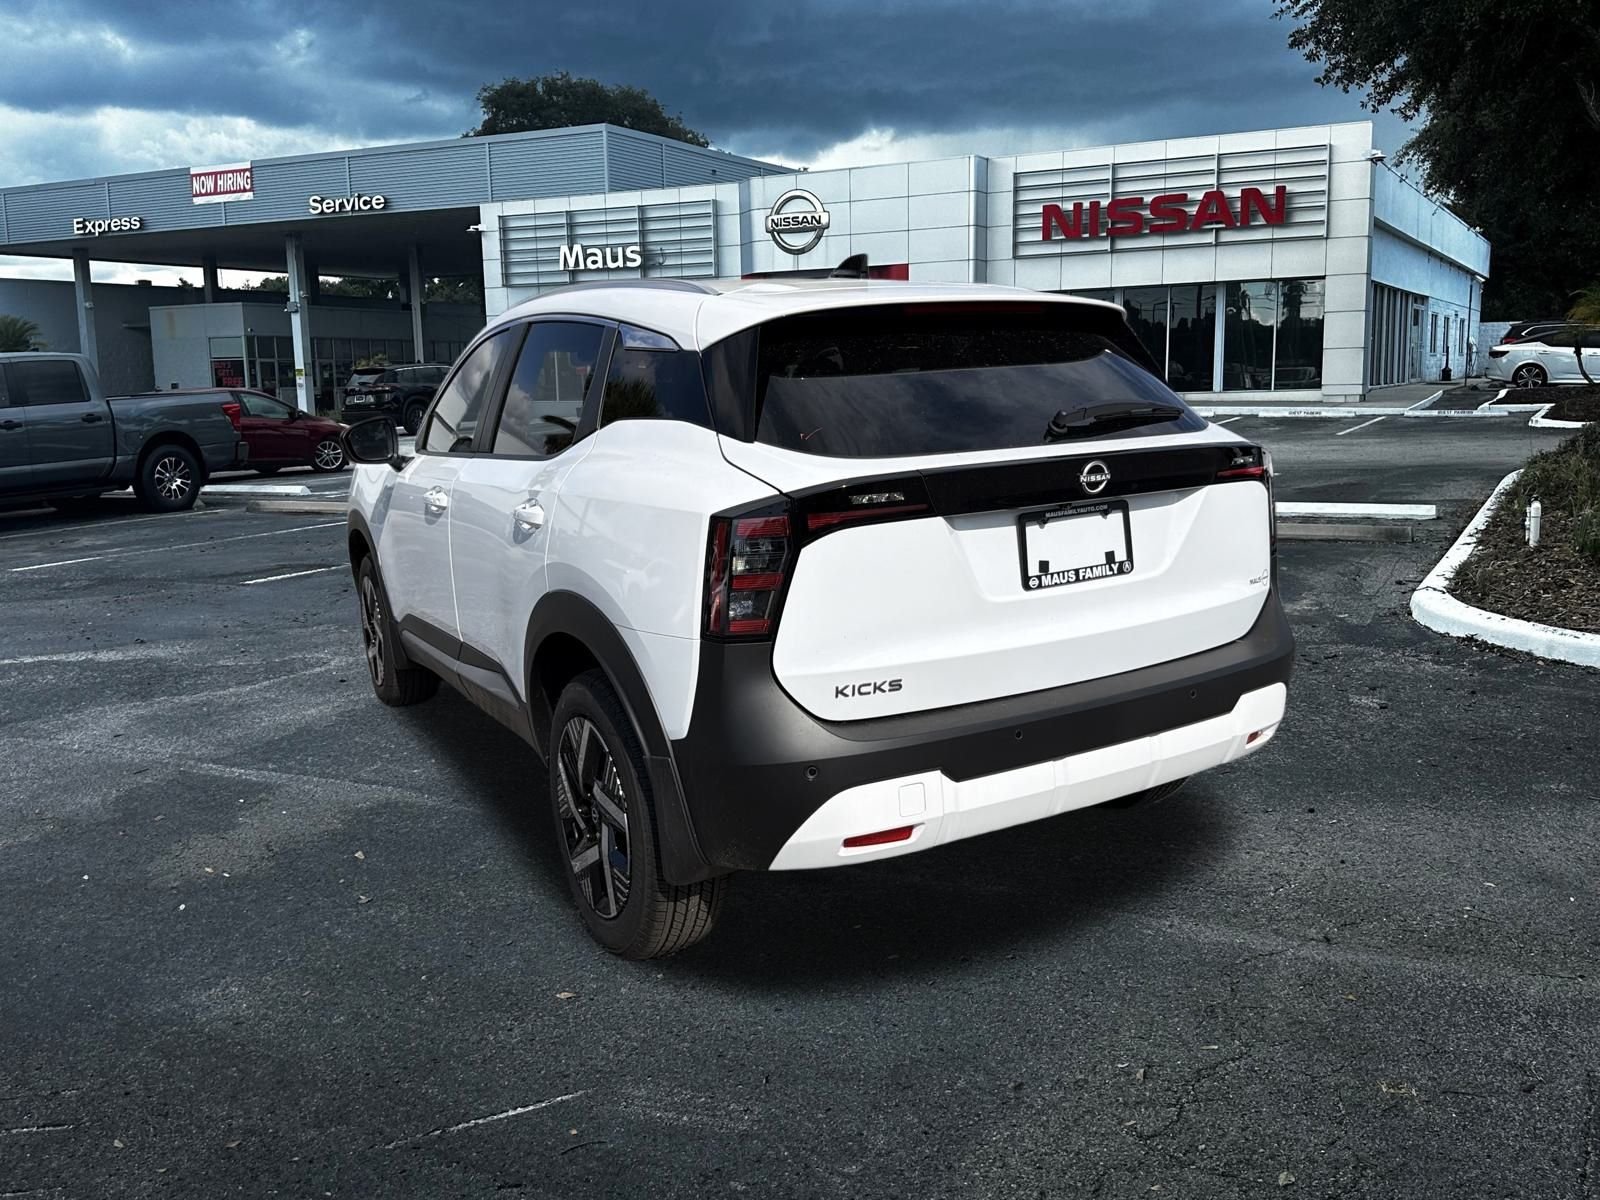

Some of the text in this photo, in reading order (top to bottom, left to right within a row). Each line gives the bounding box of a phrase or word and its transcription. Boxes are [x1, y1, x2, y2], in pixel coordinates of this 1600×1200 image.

[192, 170, 251, 195] NOW HIRING
[308, 193, 387, 215] Service
[1041, 184, 1288, 242] NISSAN
[73, 215, 142, 237] Express
[770, 213, 823, 229] NISSAN
[559, 242, 643, 271] Maus
[223, 376, 244, 386] FREE
[1080, 473, 1111, 483] NISSAN
[1045, 504, 1108, 518] MAUSFAMILYAUTO.COM
[1041, 562, 1120, 587] MAUS FAMILY
[834, 678, 904, 699] KICKS
